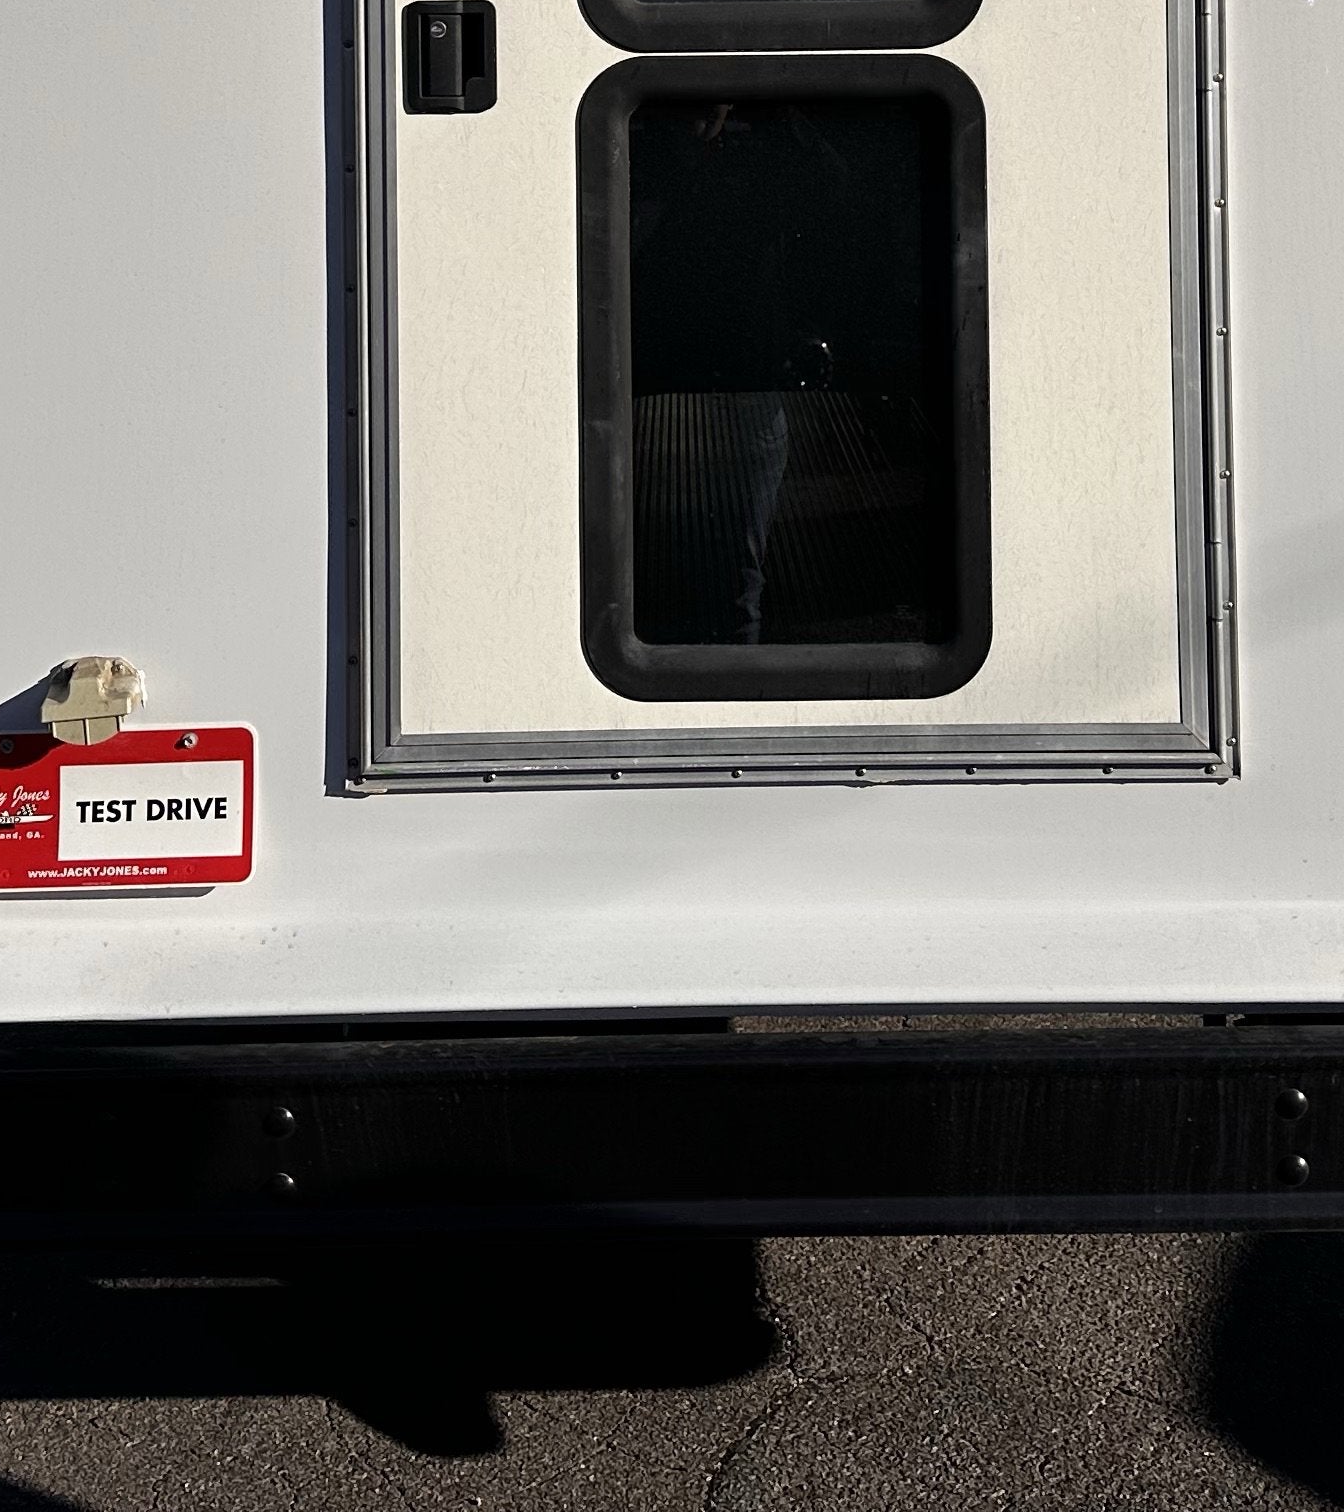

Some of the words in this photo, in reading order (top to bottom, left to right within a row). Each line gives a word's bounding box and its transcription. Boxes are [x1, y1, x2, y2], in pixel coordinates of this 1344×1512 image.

[10, 785, 50, 808] Jones
[76, 799, 137, 823] TEST
[146, 796, 228, 821] DRIVE
[27, 865, 168, 879] www.JACKYJONES.com
